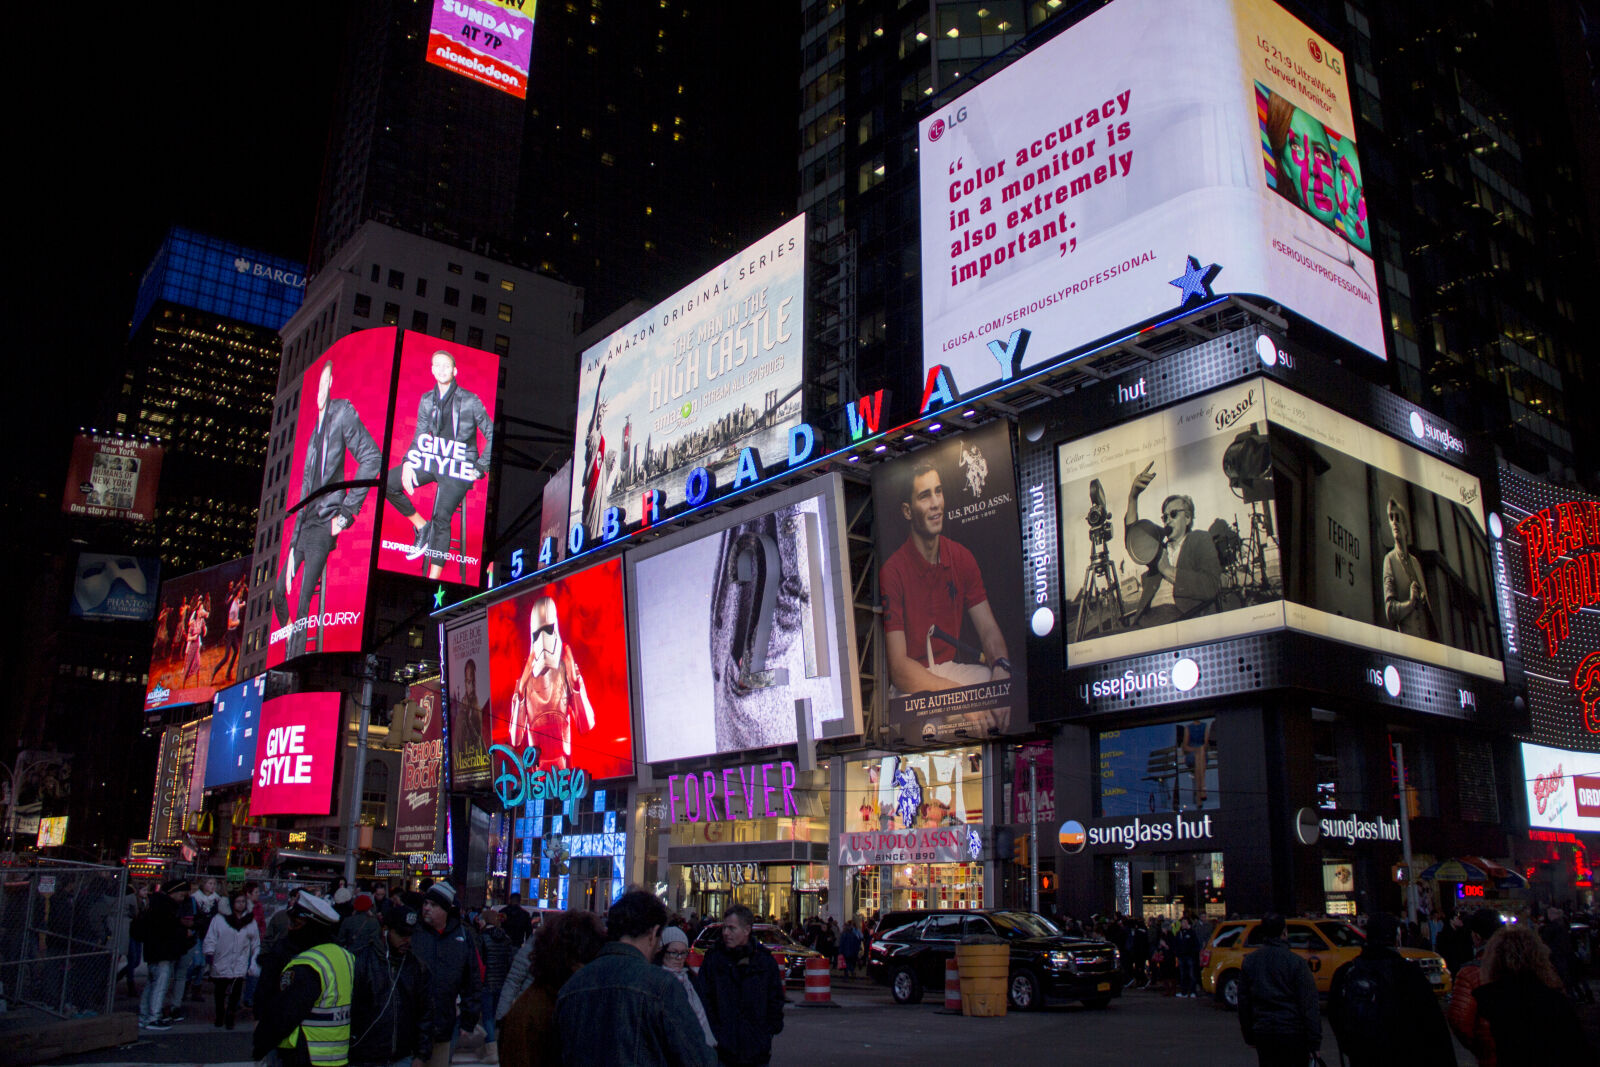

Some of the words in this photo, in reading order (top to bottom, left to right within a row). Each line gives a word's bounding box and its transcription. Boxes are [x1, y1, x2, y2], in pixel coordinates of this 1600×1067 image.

[442, 0, 525, 40] SUNDAY
[462, 23, 480, 41] AT
[484, 31, 502, 50] 7P
[436, 46, 519, 87] nickelodeon
[1256, 34, 1270, 53] LG
[1271, 46, 1292, 69] 21:9
[1293, 61, 1337, 102] UltraWide
[1324, 50, 1342, 76] LG
[1264, 57, 1297, 89] Curved
[1298, 81, 1333, 115] Monitor
[948, 107, 968, 129] LG
[949, 160, 1006, 204] Color
[1016, 88, 1131, 167] accuracy
[950, 208, 970, 231] in
[980, 196, 992, 215] a
[1001, 138, 1096, 204] monitor
[1107, 120, 1131, 149] is
[950, 221, 997, 258] also
[1006, 150, 1134, 230] extremely
[950, 211, 1077, 287] important.
[1272, 237, 1373, 305] #SERIOUSLYPROFESSIONAL
[586, 358, 601, 375] AN
[607, 322, 656, 361] AMAZON
[662, 278, 730, 327] ORIGINAL
[738, 237, 796, 281] SERIES
[942, 250, 1157, 352] LGUSA.COM/SERIOUSLYPROFESSIONAL
[672, 329, 695, 360] THE
[697, 315, 724, 345] MAN
[726, 306, 741, 330] IN
[743, 287, 769, 321] THE
[648, 347, 702, 415] HIGH
[705, 294, 794, 382] CASTLE
[702, 381, 732, 408] STREAM
[732, 374, 746, 392] ALL
[747, 354, 786, 386] EPISODES
[1117, 376, 1148, 404] hut
[1214, 387, 1258, 431] Persol
[100, 444, 118, 455] New
[417, 433, 467, 461] GIVE
[1424, 423, 1465, 454] sunglass
[406, 449, 475, 482] STYLE
[486, 521, 587, 590] 1540
[602, 328, 1032, 543] BROADWAY
[70, 503, 87, 513] One
[948, 509, 963, 521] U.S.
[963, 500, 986, 516] POLO
[987, 492, 1013, 508] ASSN.
[1029, 482, 1045, 518] hut
[1327, 514, 1360, 562] TEATRO
[1516, 500, 1600, 598] PLAN
[423, 547, 456, 562] STEPHEN
[455, 553, 479, 566] CURRY
[1033, 518, 1051, 604] sunglass
[1494, 540, 1512, 622] sunglass
[1505, 621, 1517, 654] hut
[322, 611, 361, 627] CURRY
[904, 697, 927, 713] LIVE
[927, 682, 1011, 709] AUTHENTICALLY
[1092, 669, 1168, 700] sunglass
[266, 724, 306, 757] GIVE
[404, 738, 443, 764] SCHOOL
[161, 733, 181, 818] PALACE
[258, 754, 313, 788] STYLE
[403, 759, 440, 792] ROCK
[668, 760, 800, 825] FOREVER
[1578, 787, 1600, 807] ORD
[851, 834, 875, 851] U.S.
[878, 831, 917, 850] POLO
[919, 830, 964, 848] ASSN.
[1089, 817, 1172, 850] sunglass
[1177, 814, 1214, 840] hut
[1321, 813, 1378, 846] sunglass
[1379, 815, 1402, 841] hut
[692, 863, 745, 884] FOREVER
[875, 853, 905, 862] SINCE
[1465, 884, 1484, 897] DOG
